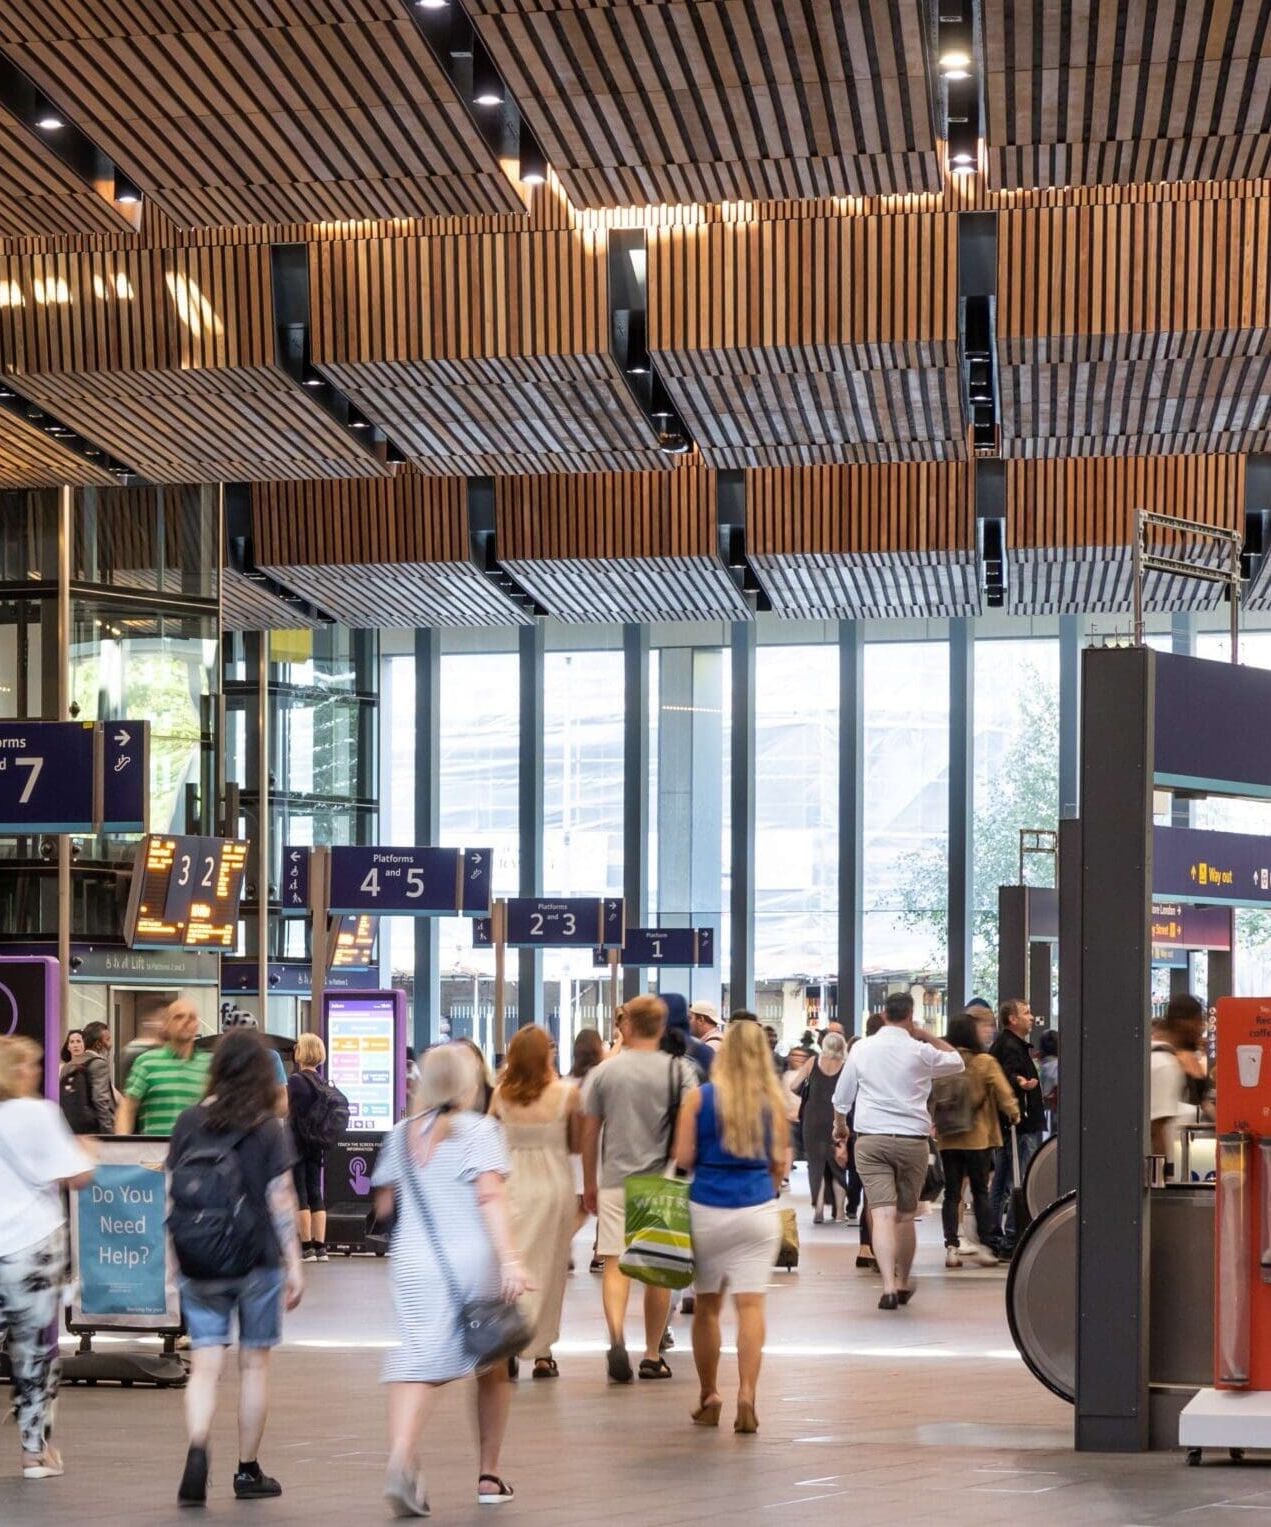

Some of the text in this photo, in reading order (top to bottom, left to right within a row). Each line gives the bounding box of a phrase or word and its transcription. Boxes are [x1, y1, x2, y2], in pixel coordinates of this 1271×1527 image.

[14, 757, 44, 804] 7
[373, 853, 414, 864] Platforms
[178, 854, 191, 886] 3
[201, 856, 215, 887] 2
[1209, 866, 1233, 887] Way out
[360, 867, 425, 898] 4 and 5
[537, 903, 569, 911] Platforms
[530, 913, 576, 936] 2 and 3
[652, 940, 664, 958] 1
[92, 1185, 154, 1204] Do You
[100, 1214, 147, 1235] Need
[99, 1246, 150, 1270] Help?
